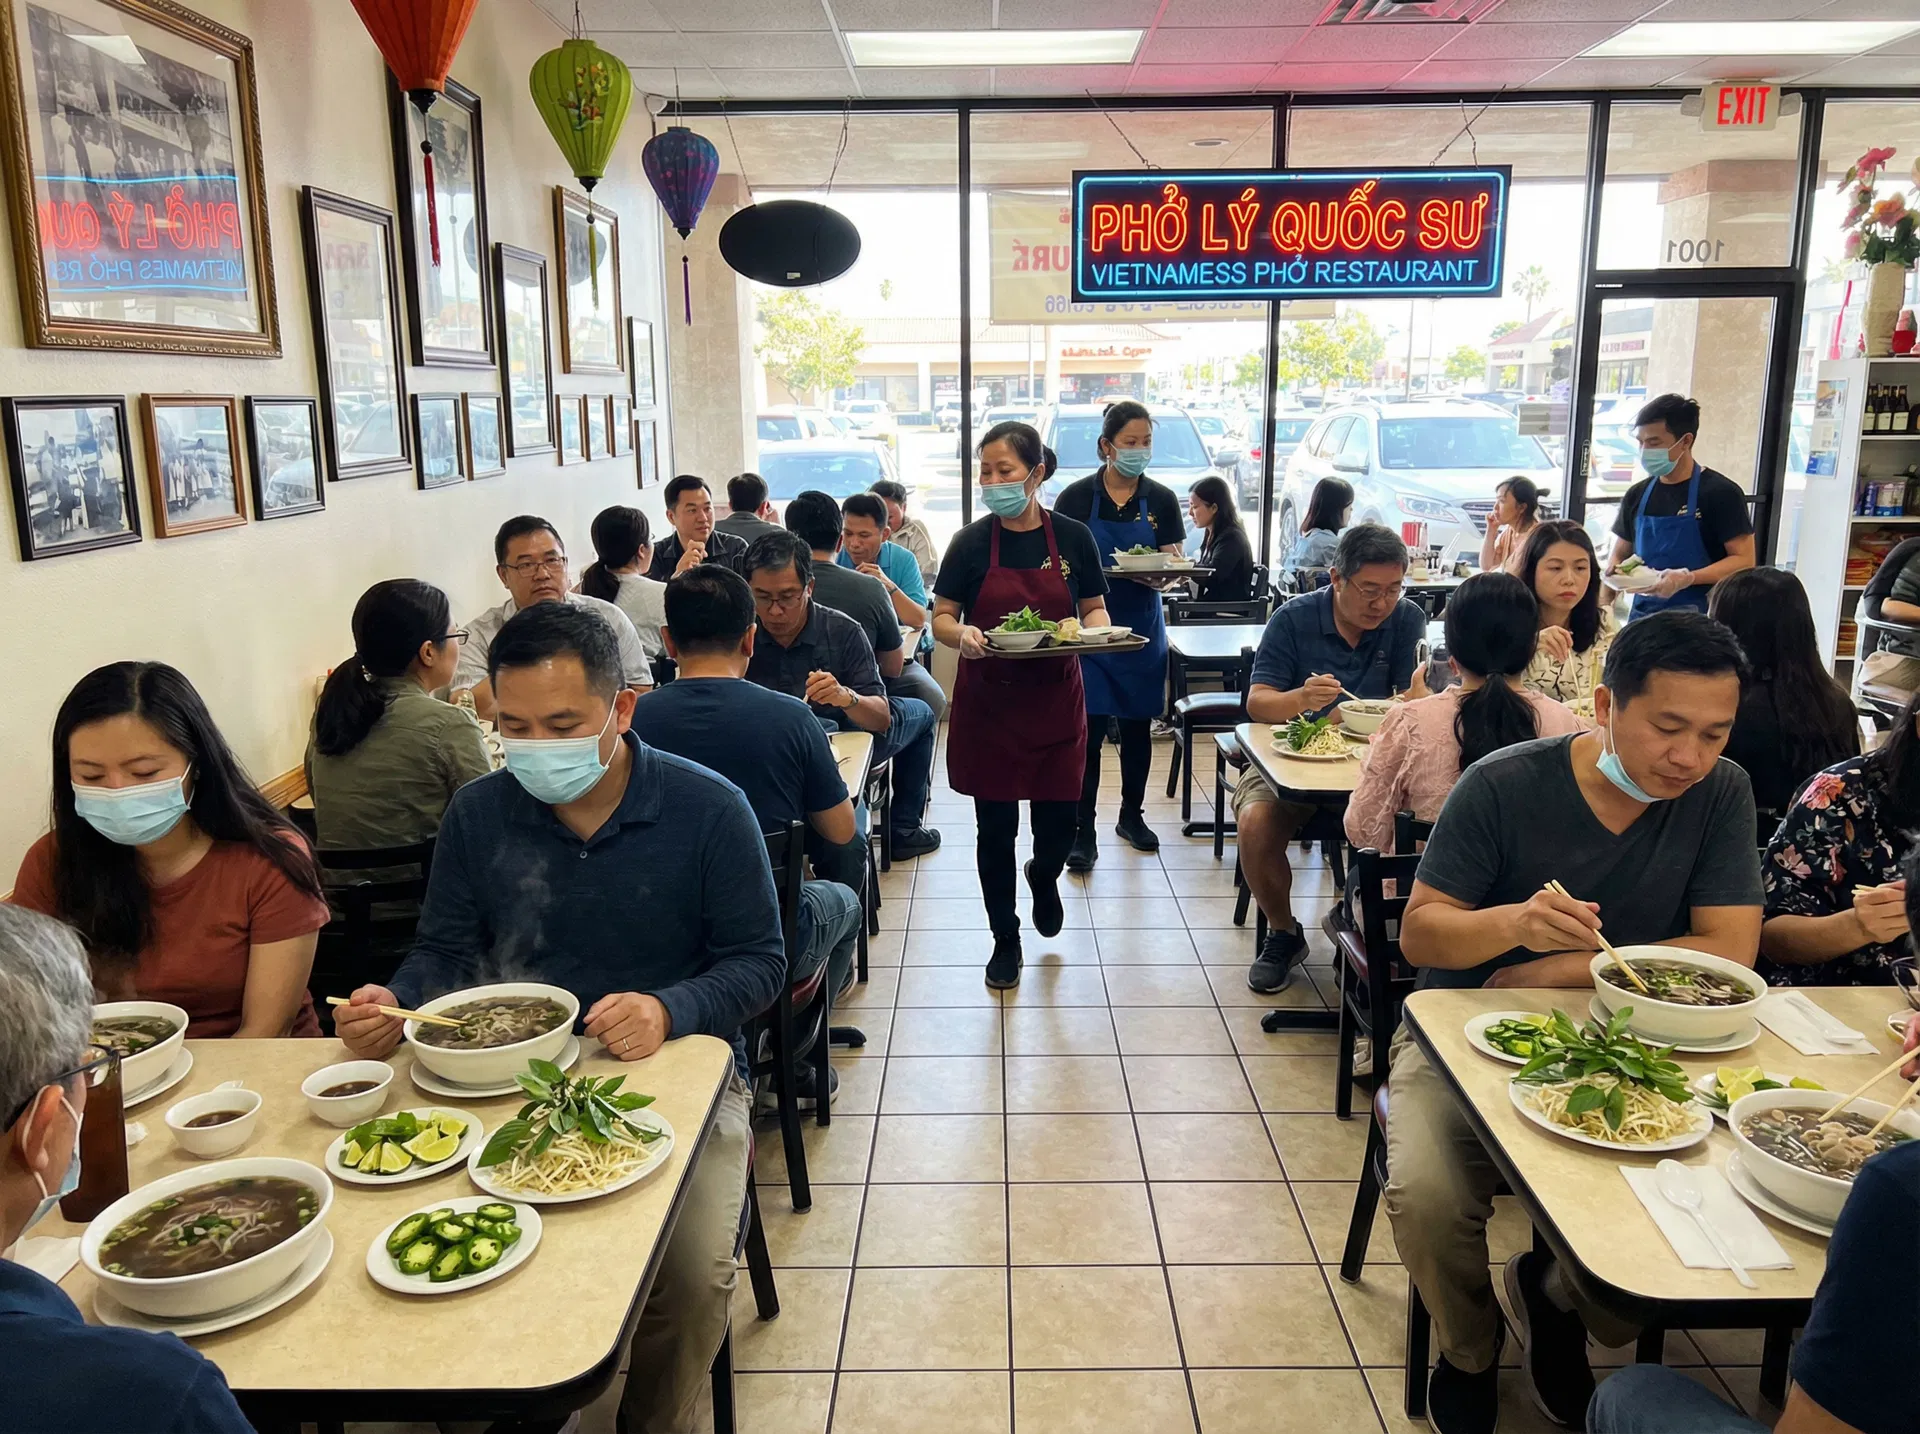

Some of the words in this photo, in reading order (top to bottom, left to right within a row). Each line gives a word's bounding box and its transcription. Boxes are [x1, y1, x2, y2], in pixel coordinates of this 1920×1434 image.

[1717, 86, 1771, 125] EXIT
[1091, 184, 1189, 252] PHỞ
[1201, 187, 1260, 252] LÝ
[1273, 180, 1407, 254] QUỐC
[1418, 193, 1487, 250] SƯ
[1091, 262, 1247, 286] VIETNAMESS
[1254, 254, 1310, 283] PHỞ
[1315, 259, 1479, 282] RESTAURANT
